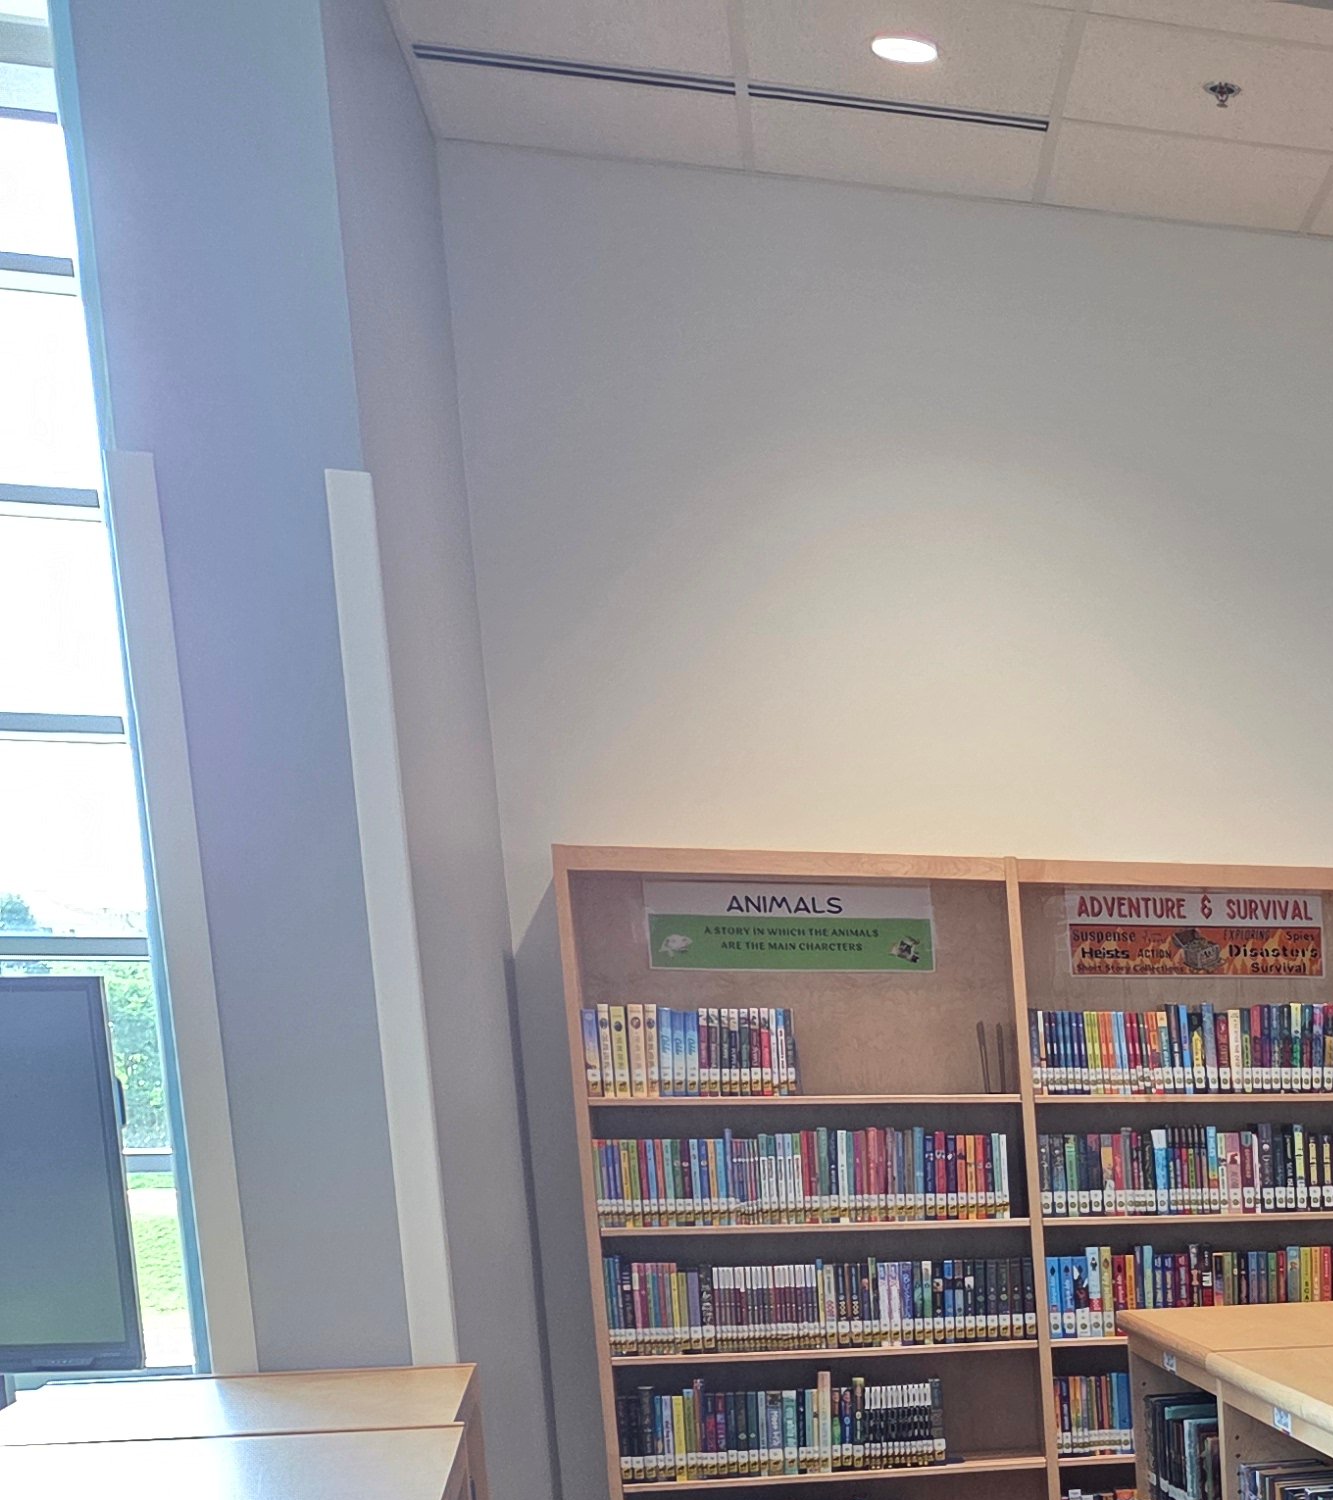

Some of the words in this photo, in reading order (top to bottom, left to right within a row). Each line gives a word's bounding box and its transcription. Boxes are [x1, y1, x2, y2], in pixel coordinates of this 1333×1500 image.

[726, 895, 843, 915] ANIMALS
[1077, 895, 1187, 919] ADVENTURE
[1200, 894, 1213, 919] &
[1226, 898, 1313, 921] SURVIVAL
[704, 926, 712, 935] A
[714, 926, 750, 936] STORY
[753, 927, 765, 936] IN
[767, 927, 806, 937] WHICH
[808, 927, 829, 937] THE
[830, 928, 879, 938] ANIMALS
[1073, 929, 1136, 943] Suspense
[721, 941, 742, 951] ARE
[744, 941, 766, 951] THE
[767, 942, 797, 951] MAIN
[798, 942, 863, 952] CHARCTERS
[1229, 944, 1318, 958] Disasters
[1081, 947, 1130, 959] Heists
[1137, 949, 1172, 958] ACTION
[1077, 964, 1102, 973] Short
[1106, 964, 1130, 973] Story
[1133, 964, 1185, 973] Collections
[1251, 962, 1307, 973] Survival
